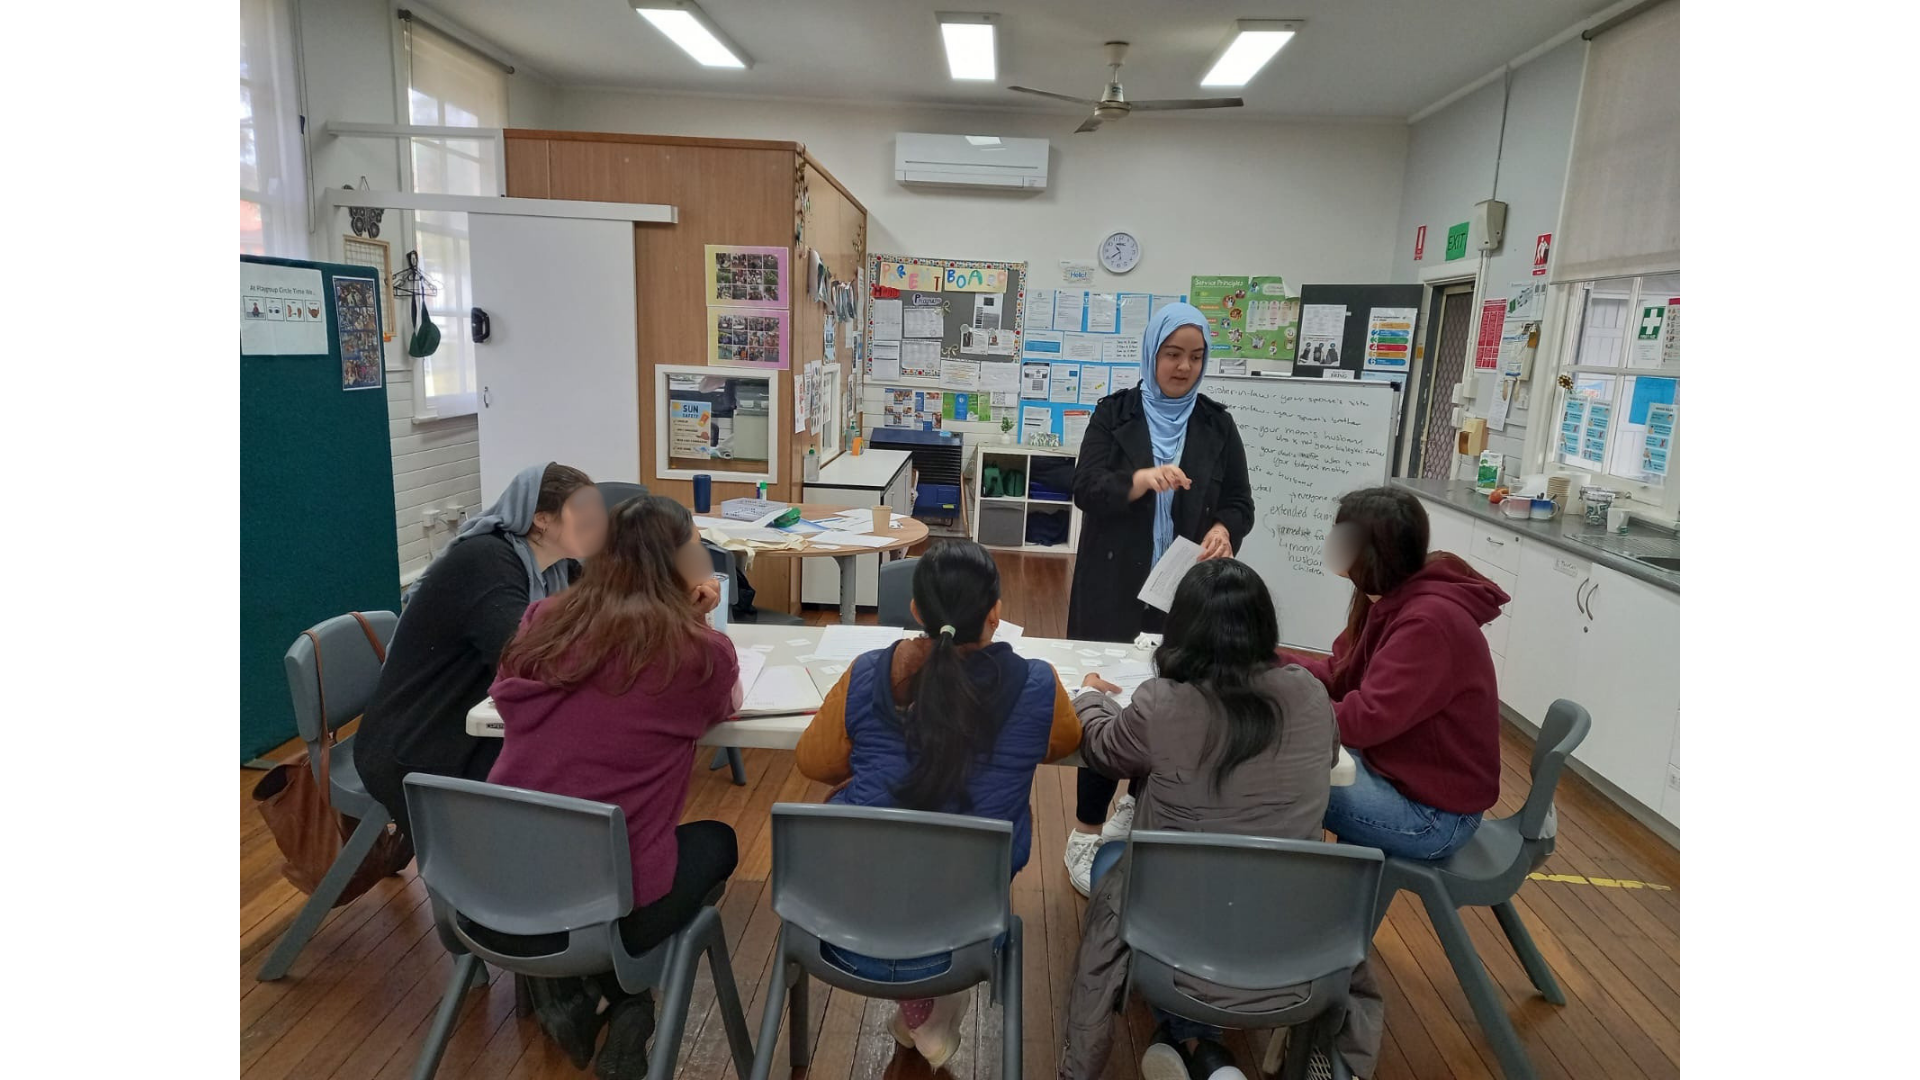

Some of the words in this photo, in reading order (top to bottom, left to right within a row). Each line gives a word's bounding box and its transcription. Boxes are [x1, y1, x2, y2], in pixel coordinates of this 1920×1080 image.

[1448, 232, 1465, 251] EXIT
[1194, 278, 1217, 286] Service
[1280, 394, 1304, 404] your
[683, 404, 698, 413] SUN
[1259, 426, 1280, 438] your
[1260, 446, 1277, 457] your
[1297, 492, 1328, 503] everyone
[1270, 504, 1309, 519] extended
